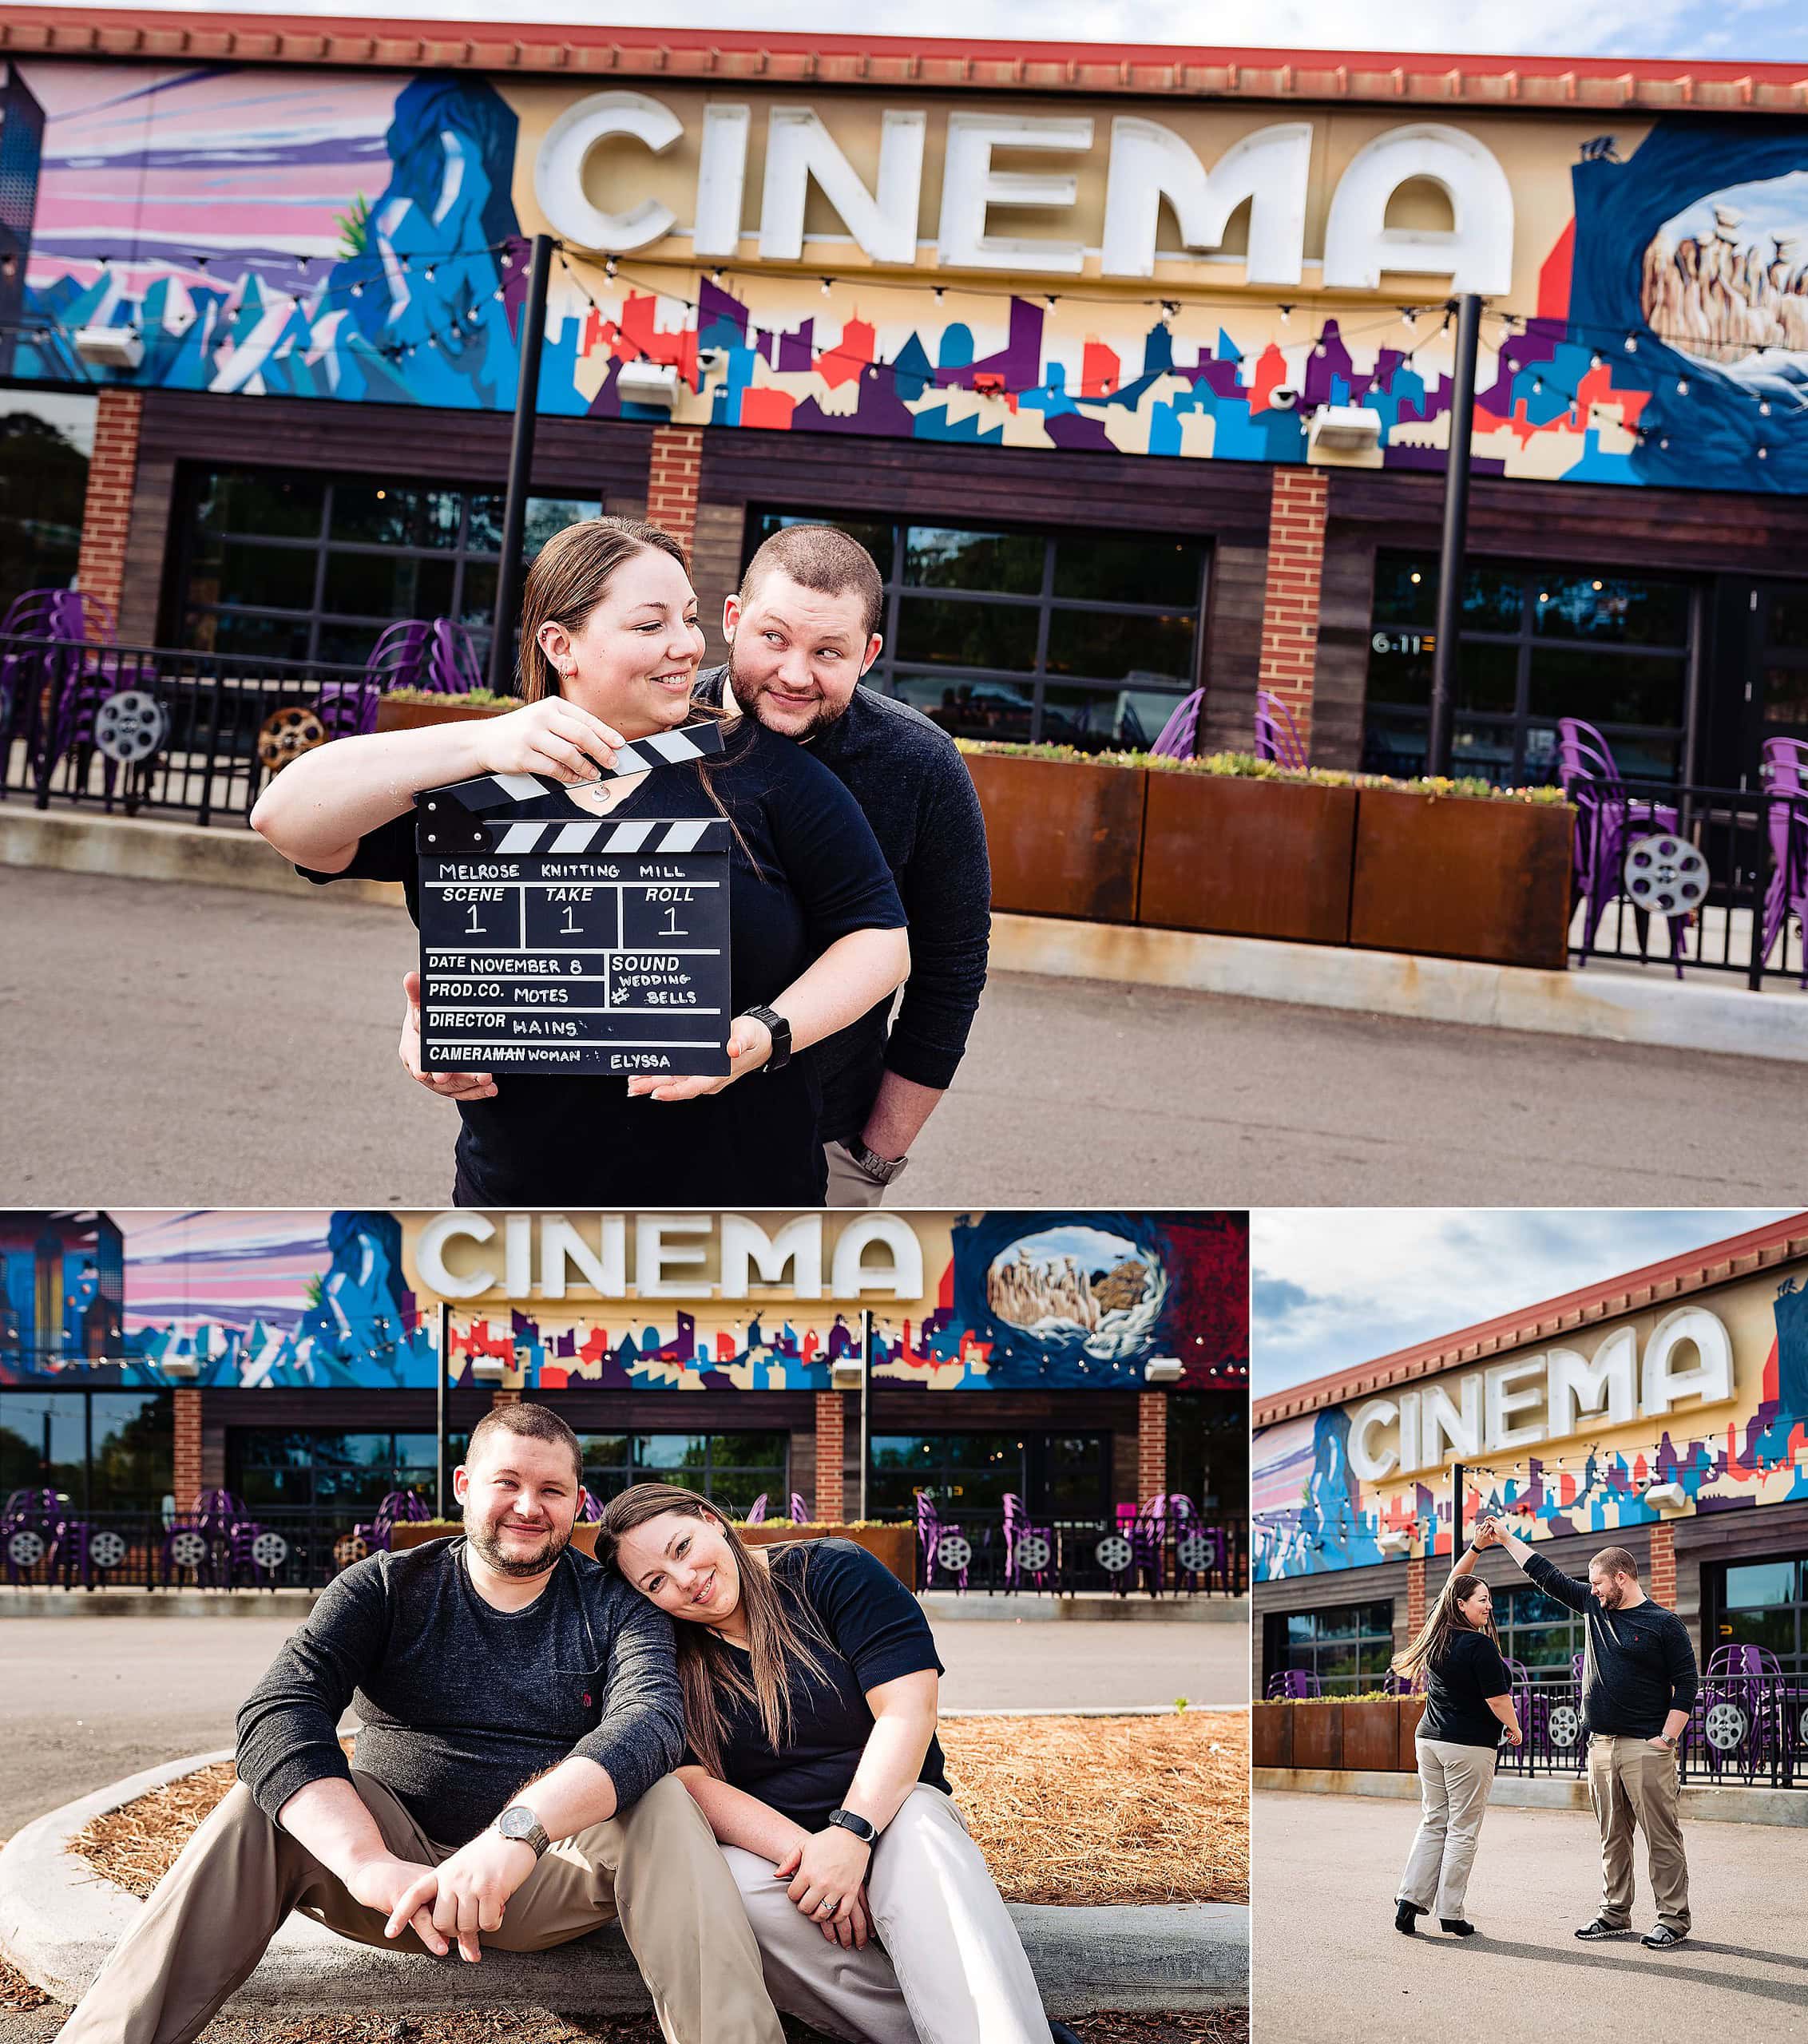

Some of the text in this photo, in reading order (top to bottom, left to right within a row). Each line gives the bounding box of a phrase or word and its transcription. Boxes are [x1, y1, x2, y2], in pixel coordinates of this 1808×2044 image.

[533, 89, 1515, 297] CINEMA
[440, 864, 686, 880] MELROSE KNITTING MILL
[442, 888, 694, 902] SCENE TAKE ROLL
[465, 904, 689, 937] 1 1 1
[429, 956, 466, 969] DATE
[470, 960, 583, 975] NOVEMBER 8
[612, 956, 680, 972] SOUND
[619, 974, 692, 988] WEDDING
[429, 983, 505, 997] PROD.CO.
[514, 988, 569, 1004] MOTES
[645, 991, 697, 1004] BELLS
[429, 1013, 506, 1028] DIRECTOR
[513, 1020, 578, 1036] HAINS
[527, 1049, 581, 1063] WOMAN
[610, 1054, 671, 1069] ELYSSA
[415, 1211, 924, 1299] CINEMA
[1347, 1305, 1735, 1482] CINEMA
